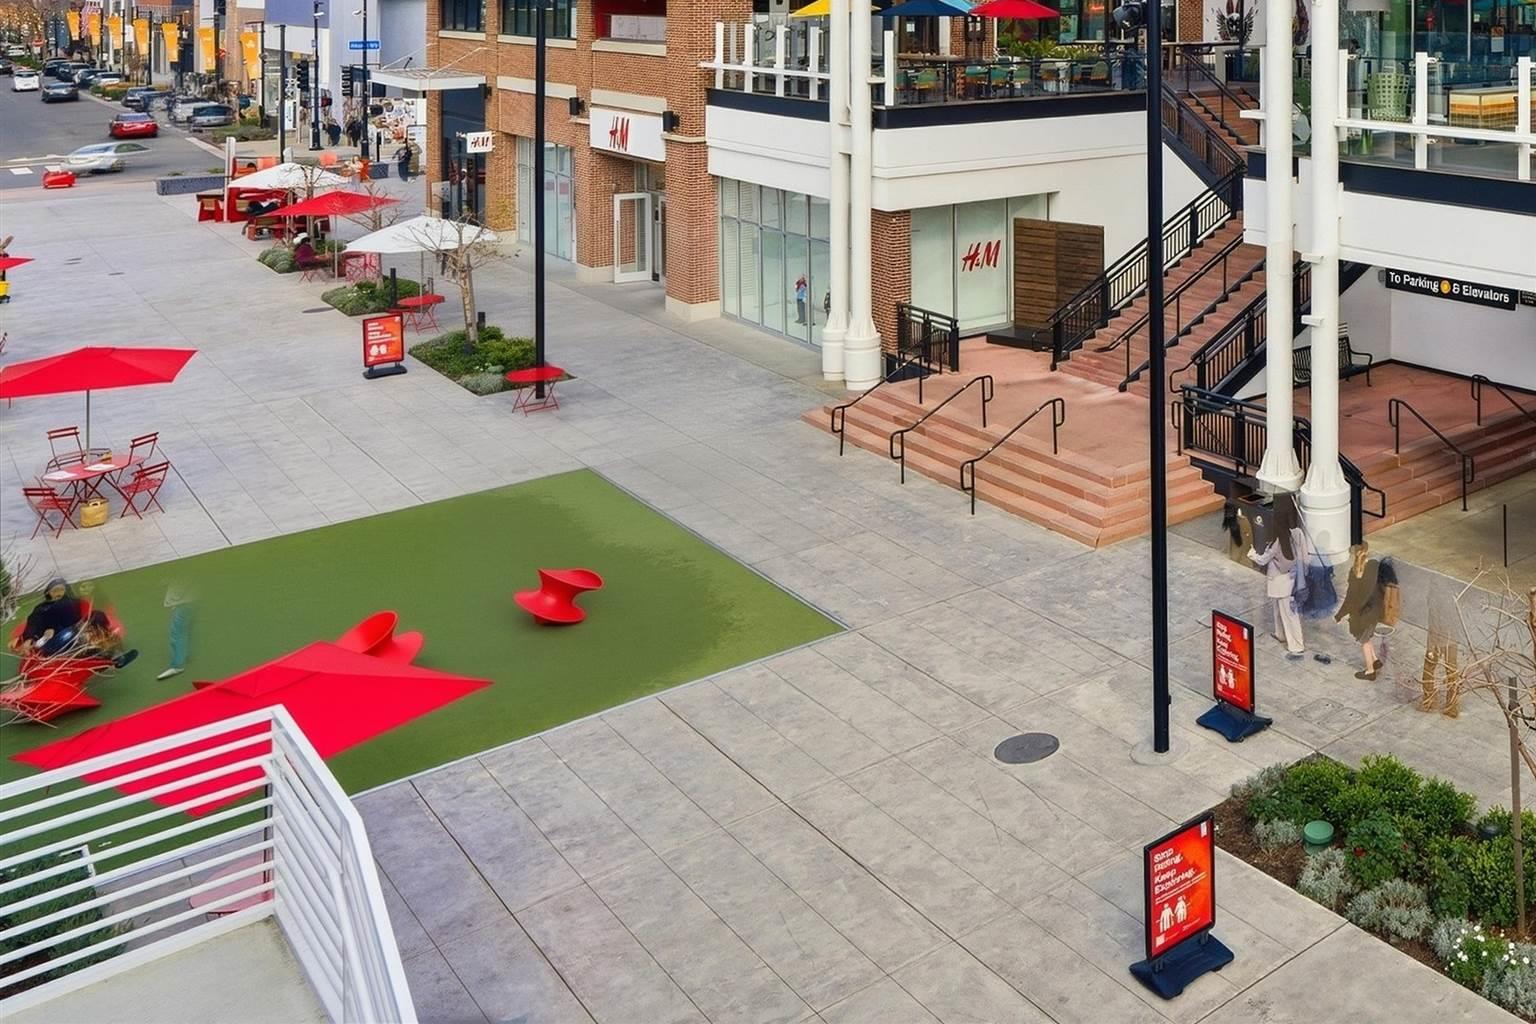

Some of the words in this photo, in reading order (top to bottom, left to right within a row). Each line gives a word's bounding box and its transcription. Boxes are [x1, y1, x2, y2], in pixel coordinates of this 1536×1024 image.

[962, 239, 1001, 272] H&M
[1389, 272, 1401, 284] To
[1403, 274, 1439, 293] Parking
[1462, 284, 1510, 303] Elevators
